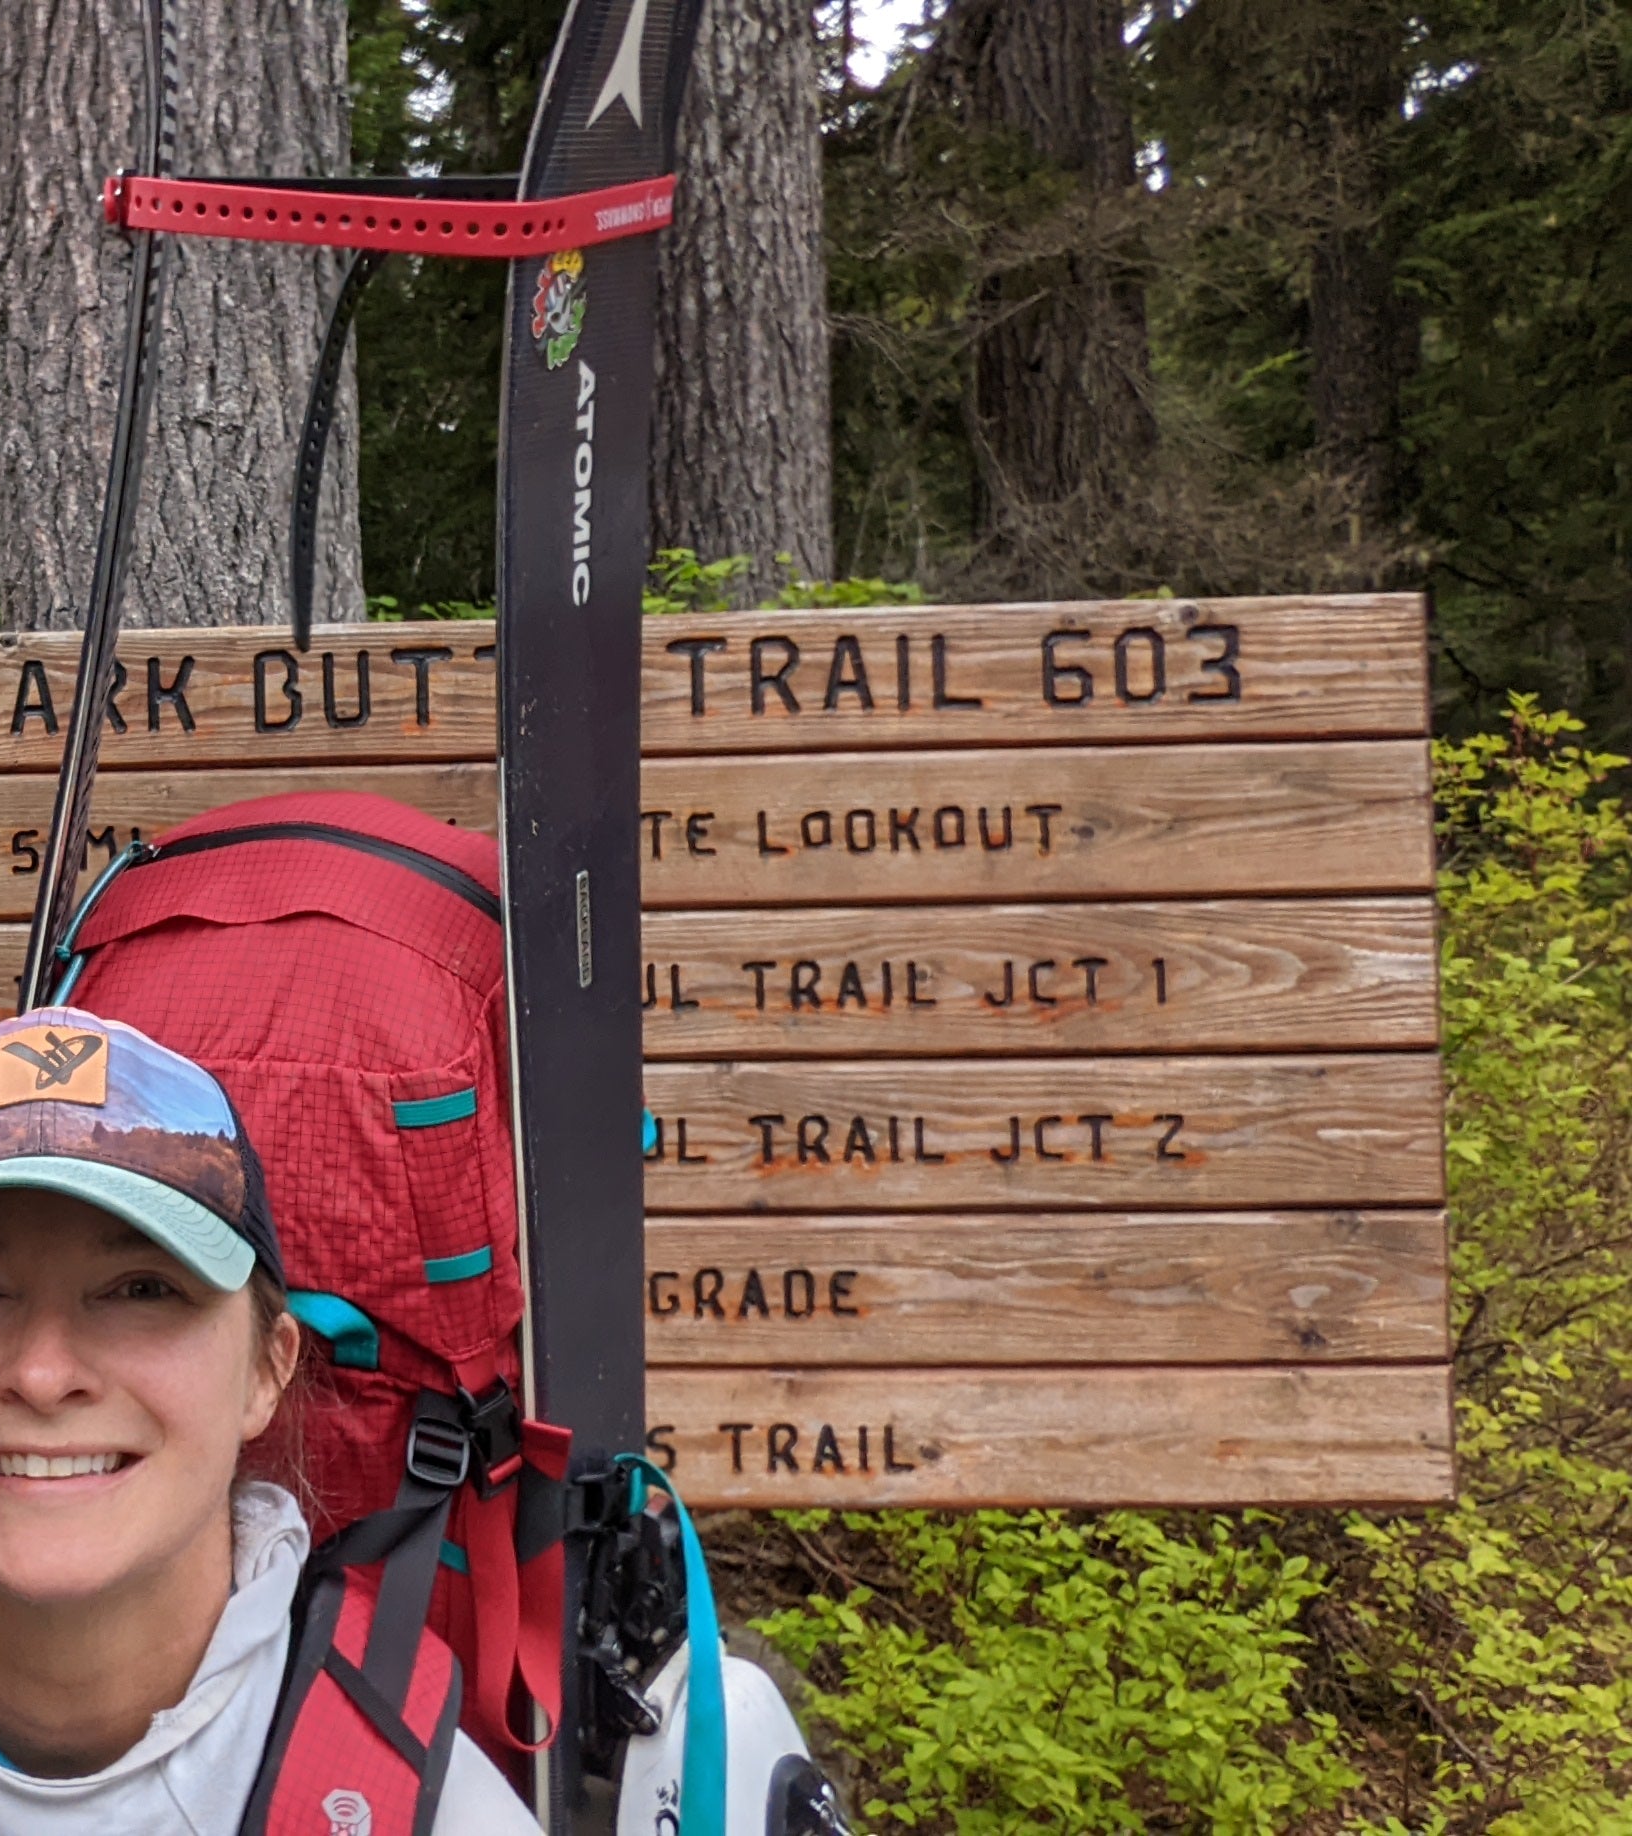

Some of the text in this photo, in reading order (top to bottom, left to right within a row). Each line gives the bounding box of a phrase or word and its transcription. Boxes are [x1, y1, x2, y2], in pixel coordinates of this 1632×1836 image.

[572, 359, 596, 606] ATOMIC
[254, 645, 497, 734] BUT
[666, 623, 1242, 717] TRAIL 603
[640, 804, 1063, 861] TE LOOKOUT
[741, 959, 937, 1011] TRAIL
[983, 957, 1109, 1009] JCT
[1151, 957, 1167, 1007] 1
[748, 1113, 946, 1165] TRAIL
[989, 1113, 1114, 1164] JCT
[1153, 1112, 1187, 1161] 2
[648, 1267, 860, 1320] GRADE
[718, 1422, 916, 1475] TRAIL
